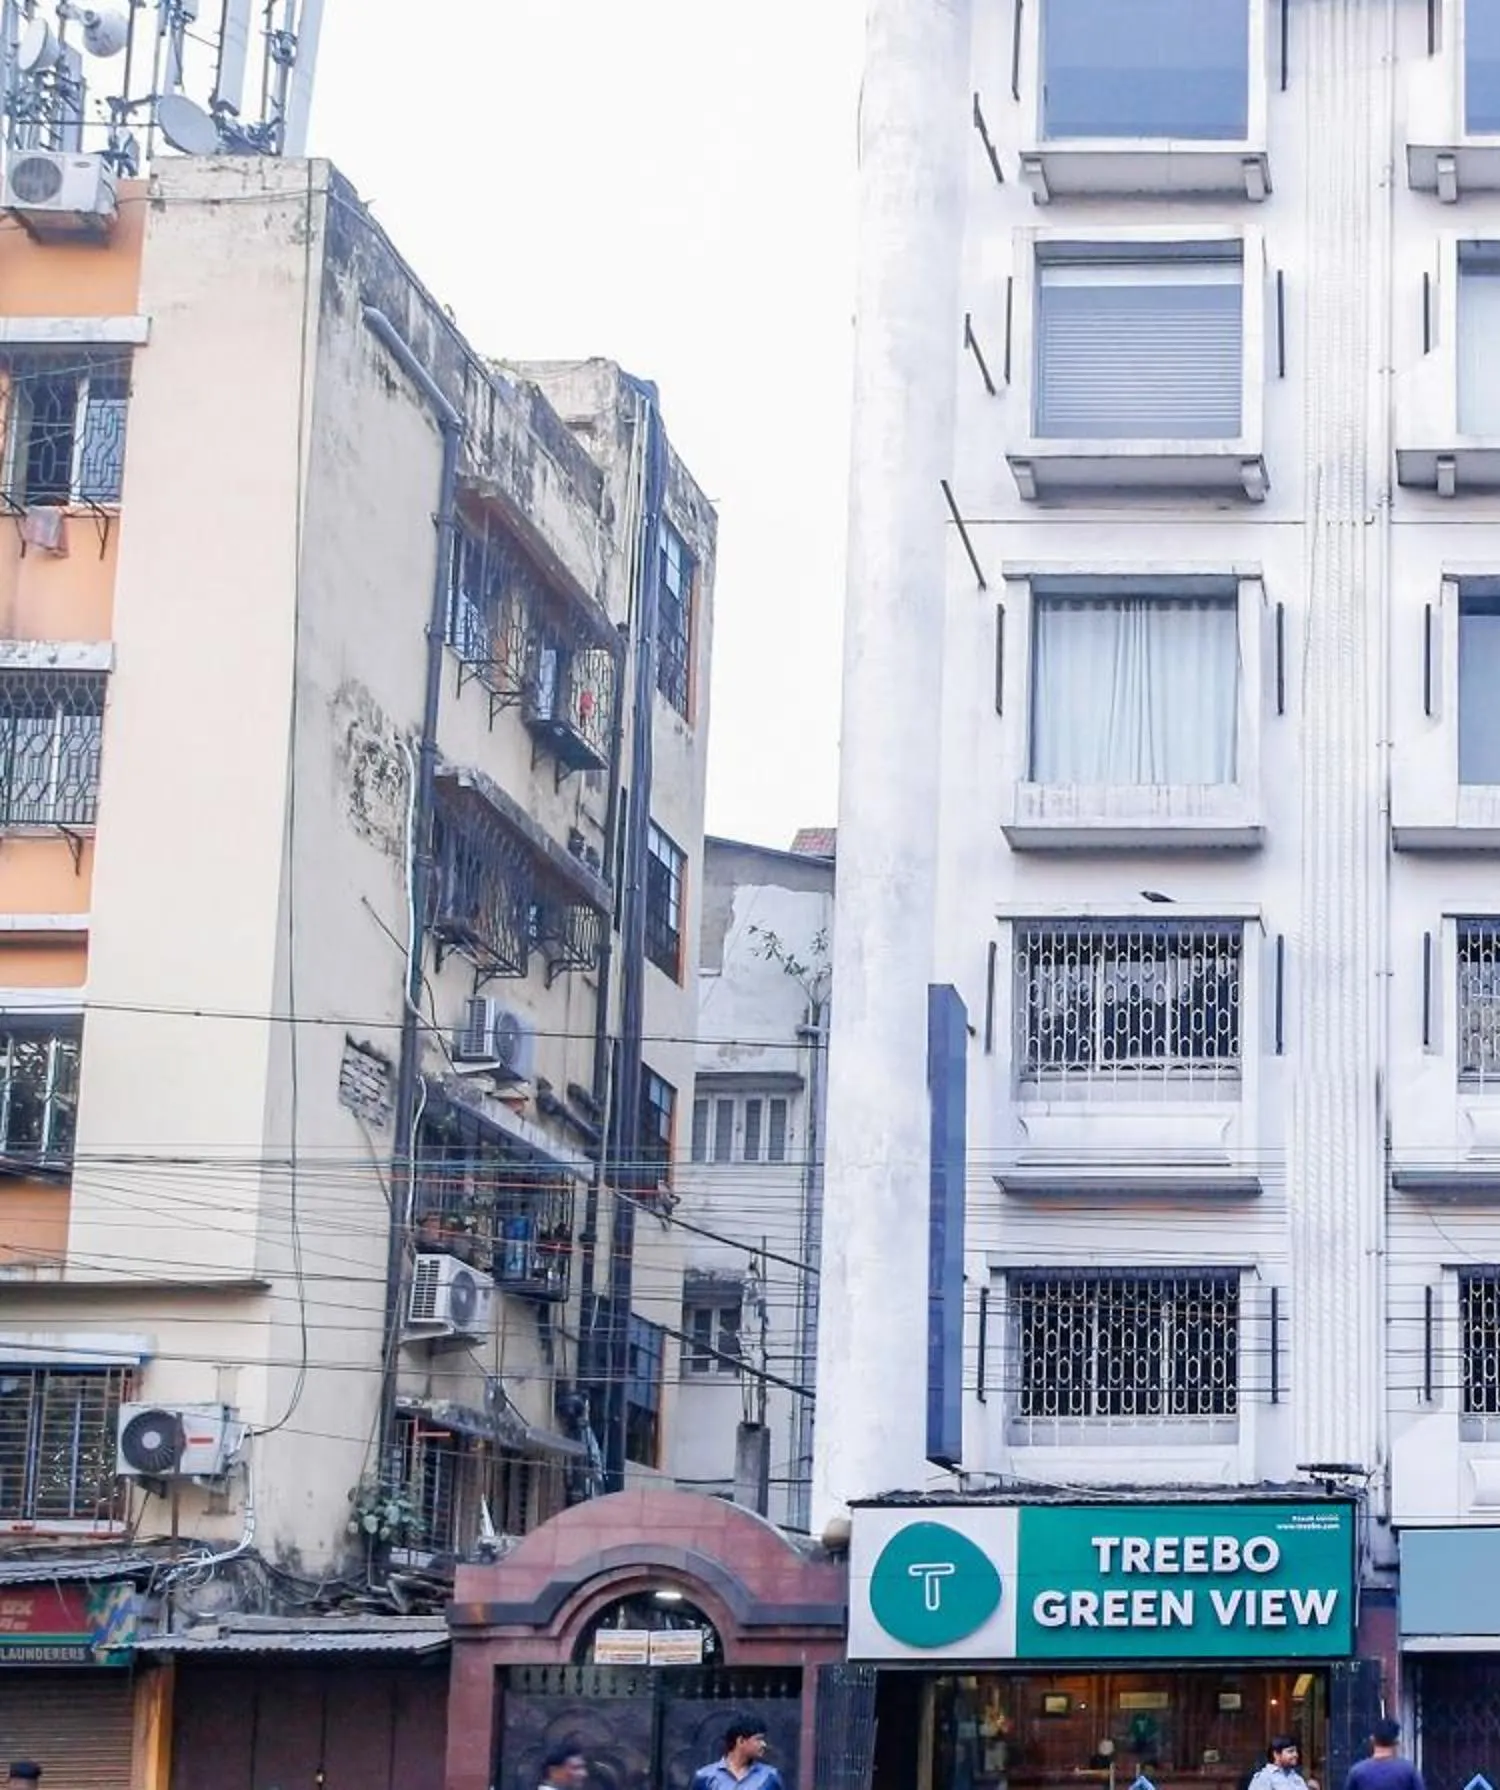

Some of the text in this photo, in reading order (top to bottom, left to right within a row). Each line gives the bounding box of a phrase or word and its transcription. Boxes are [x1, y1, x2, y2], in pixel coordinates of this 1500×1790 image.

[1091, 1535, 1280, 1573] TREEBO
[908, 1562, 956, 1611] T
[1032, 1588, 1339, 1628] GREEN VIEW
